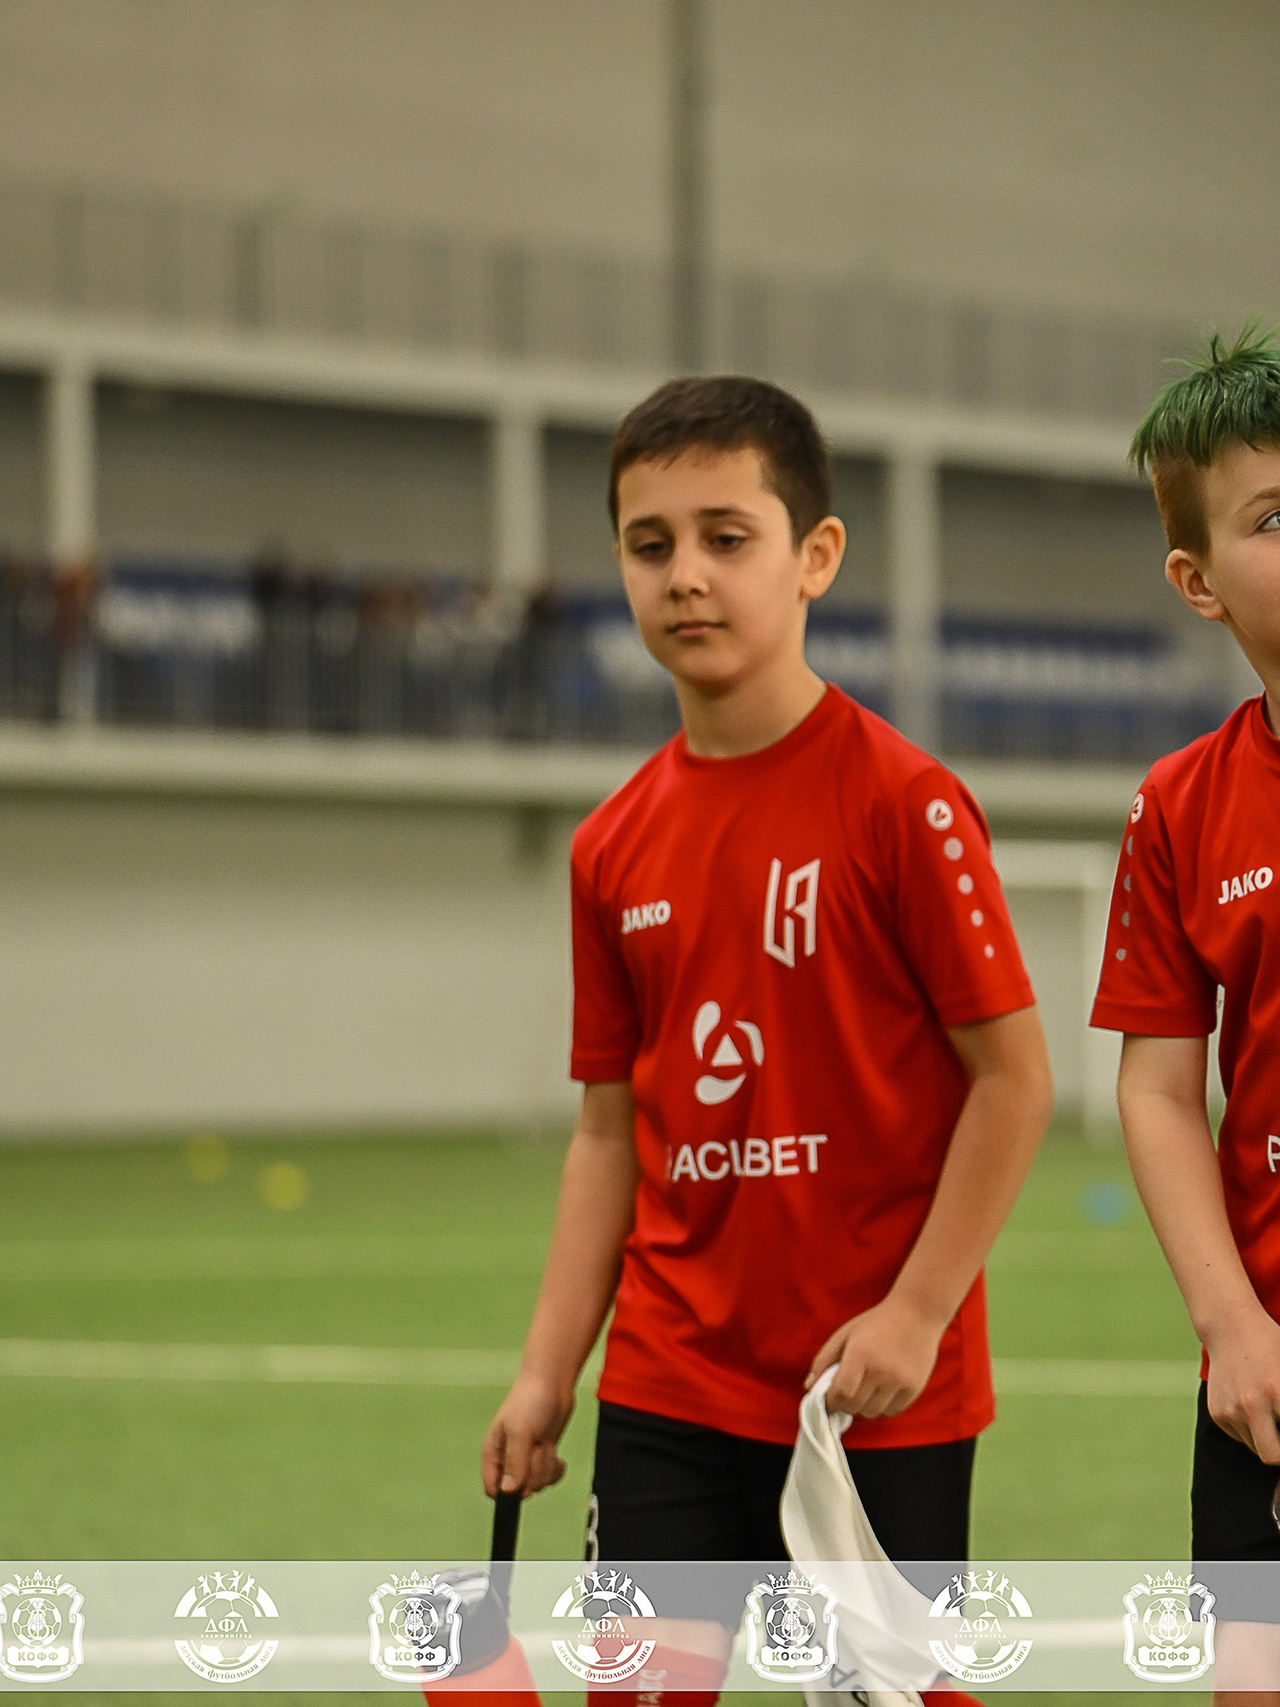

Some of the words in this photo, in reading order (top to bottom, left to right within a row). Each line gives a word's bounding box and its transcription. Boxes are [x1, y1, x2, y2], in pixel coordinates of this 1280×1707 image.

[1218, 866, 1273, 905] JAKO
[622, 900, 671, 933] JAKO
[667, 1133, 828, 1184] АСВЕТ
